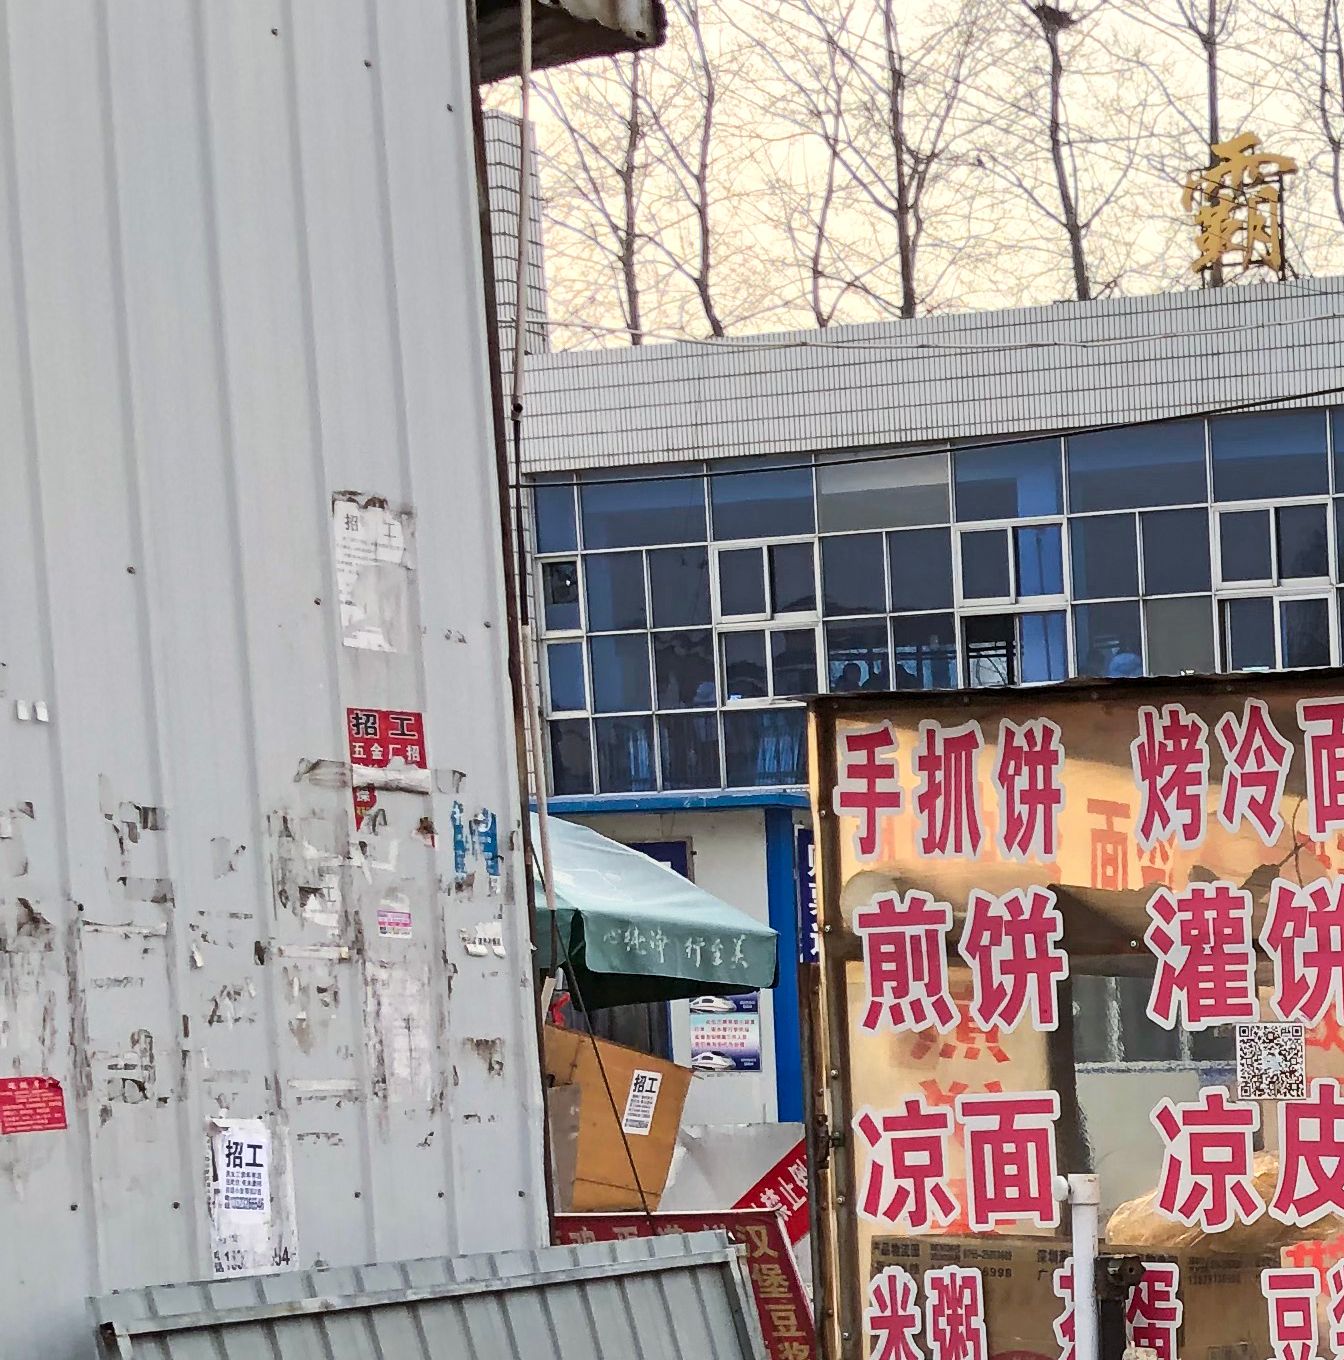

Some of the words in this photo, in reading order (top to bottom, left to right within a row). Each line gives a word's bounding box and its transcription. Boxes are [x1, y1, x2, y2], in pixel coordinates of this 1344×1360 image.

[351, 712, 417, 739] 招工
[840, 725, 1063, 858] 手抓饼
[859, 889, 1064, 1031] 煎饼
[633, 1074, 658, 1093] 招工
[225, 1140, 265, 1168] 招工
[859, 1097, 1058, 1223] 凉面
